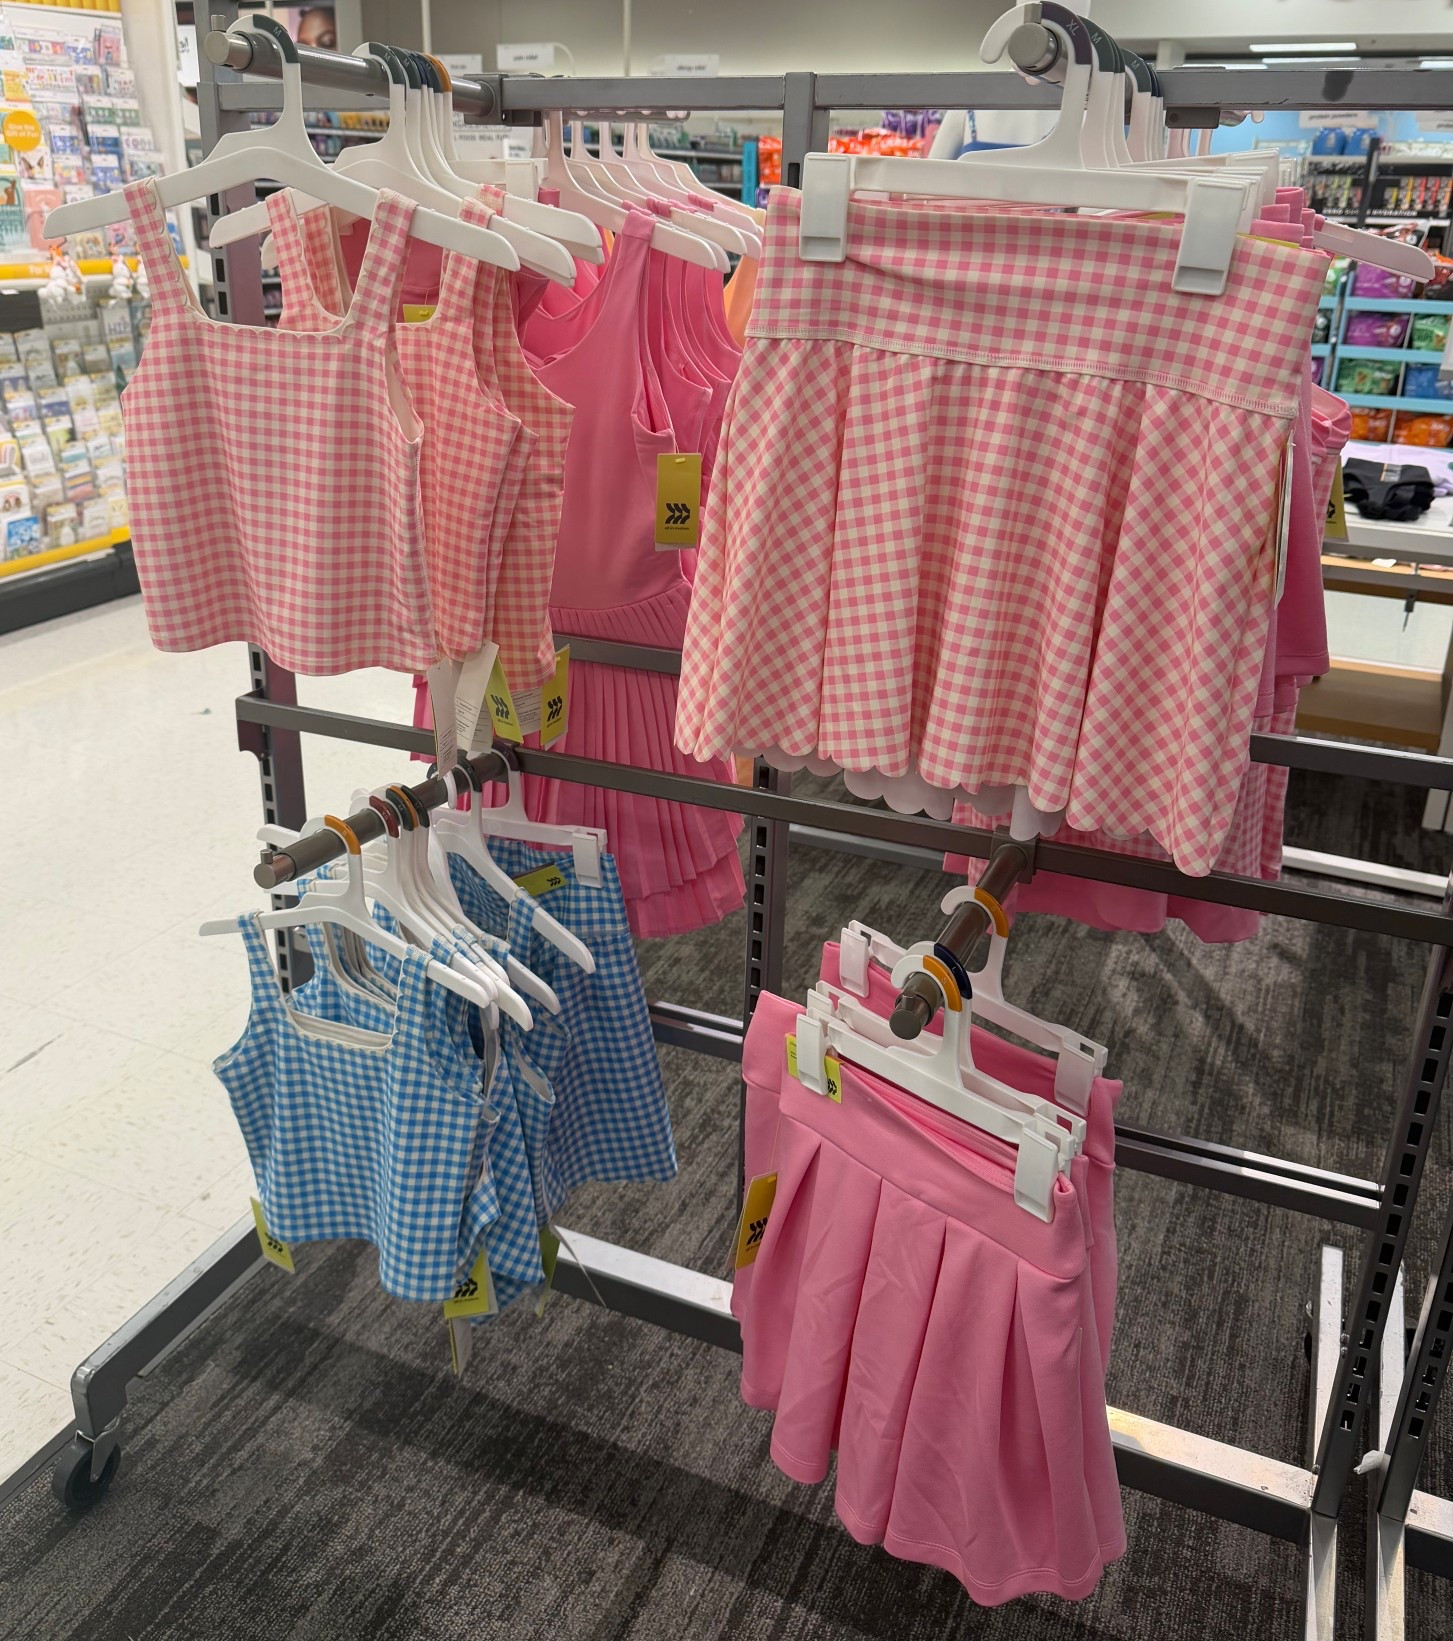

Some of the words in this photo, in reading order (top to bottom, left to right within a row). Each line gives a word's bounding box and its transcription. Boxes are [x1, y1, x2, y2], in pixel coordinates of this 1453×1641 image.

[273, 26, 282, 37] M
[1066, 19, 1080, 36] XL
[1091, 32, 1102, 44] M
[403, 58, 410, 68] M
[1131, 59, 1140, 70] M
